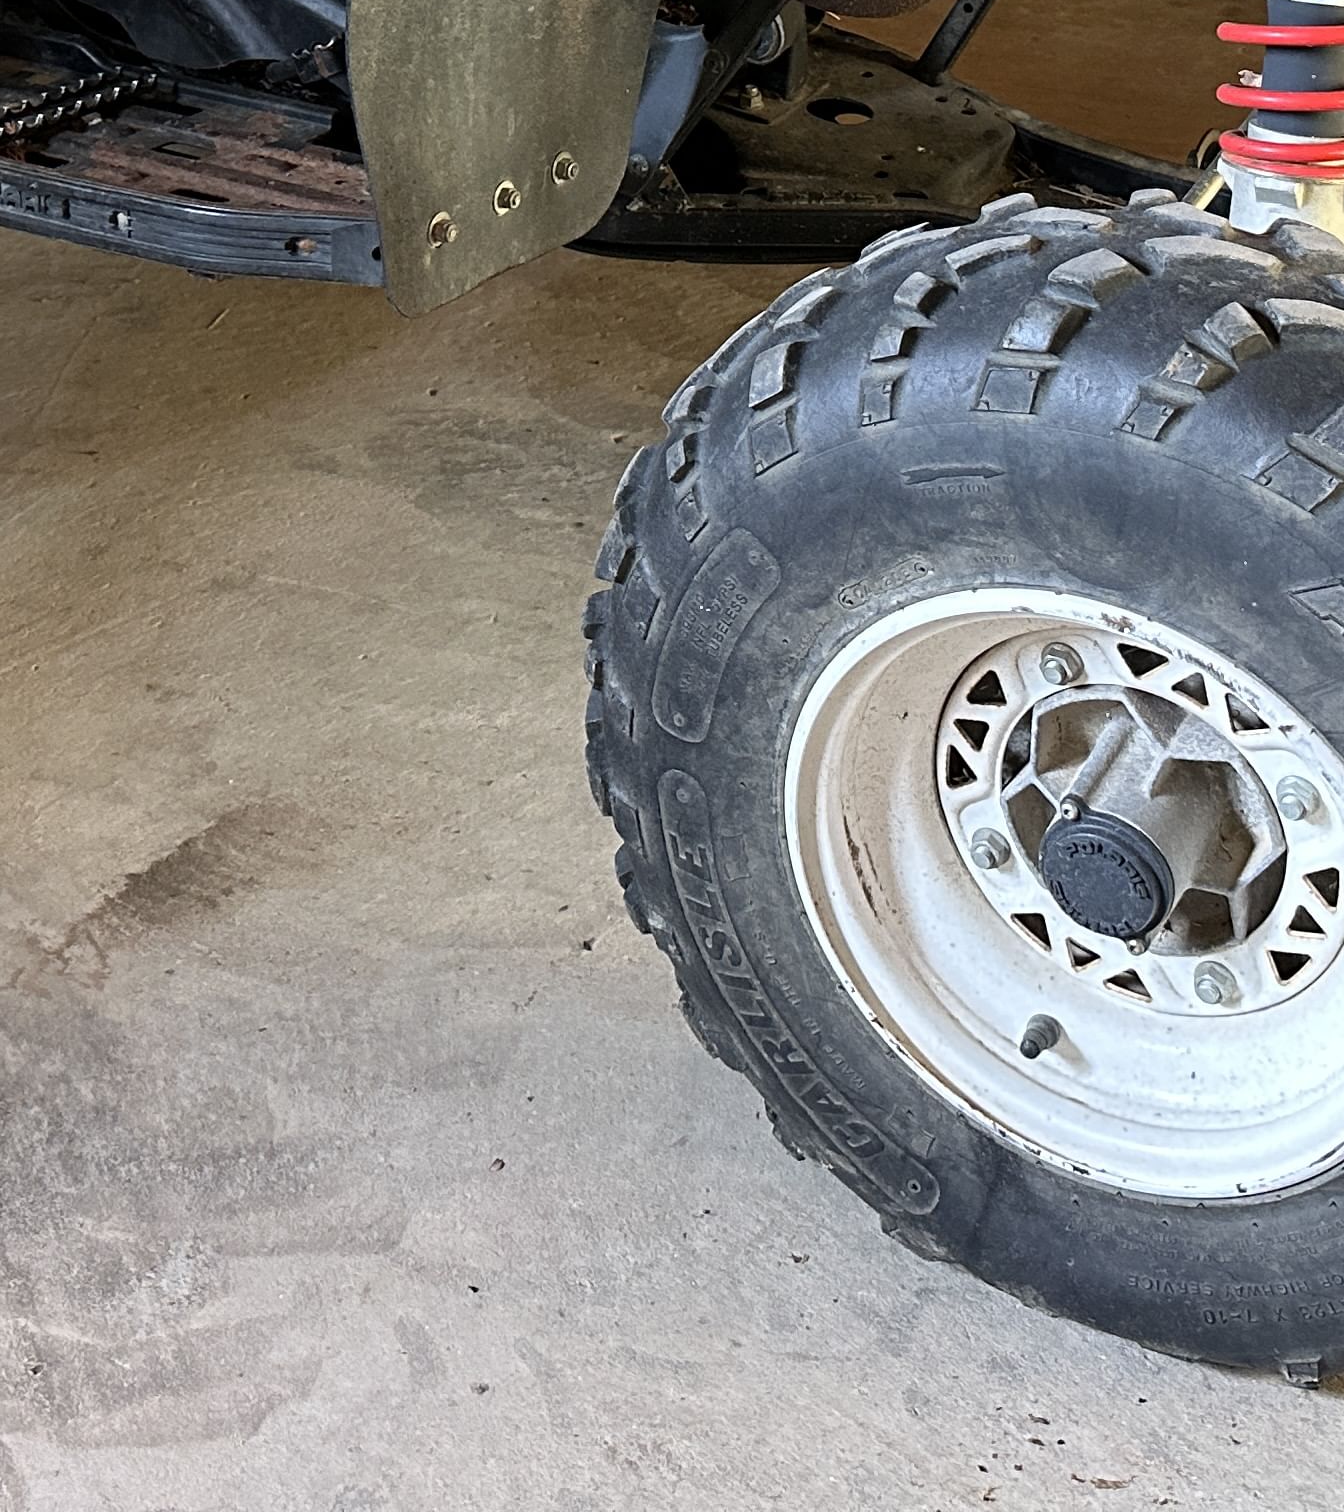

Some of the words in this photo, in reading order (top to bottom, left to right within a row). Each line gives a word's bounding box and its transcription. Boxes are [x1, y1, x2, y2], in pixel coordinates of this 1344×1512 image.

[669, 832, 886, 1159] CARLISLE
[1128, 1274, 1213, 1297] SERVICE
[1226, 1280, 1311, 1299] HIGHWAY
[1202, 1308, 1258, 1326] 7-10
